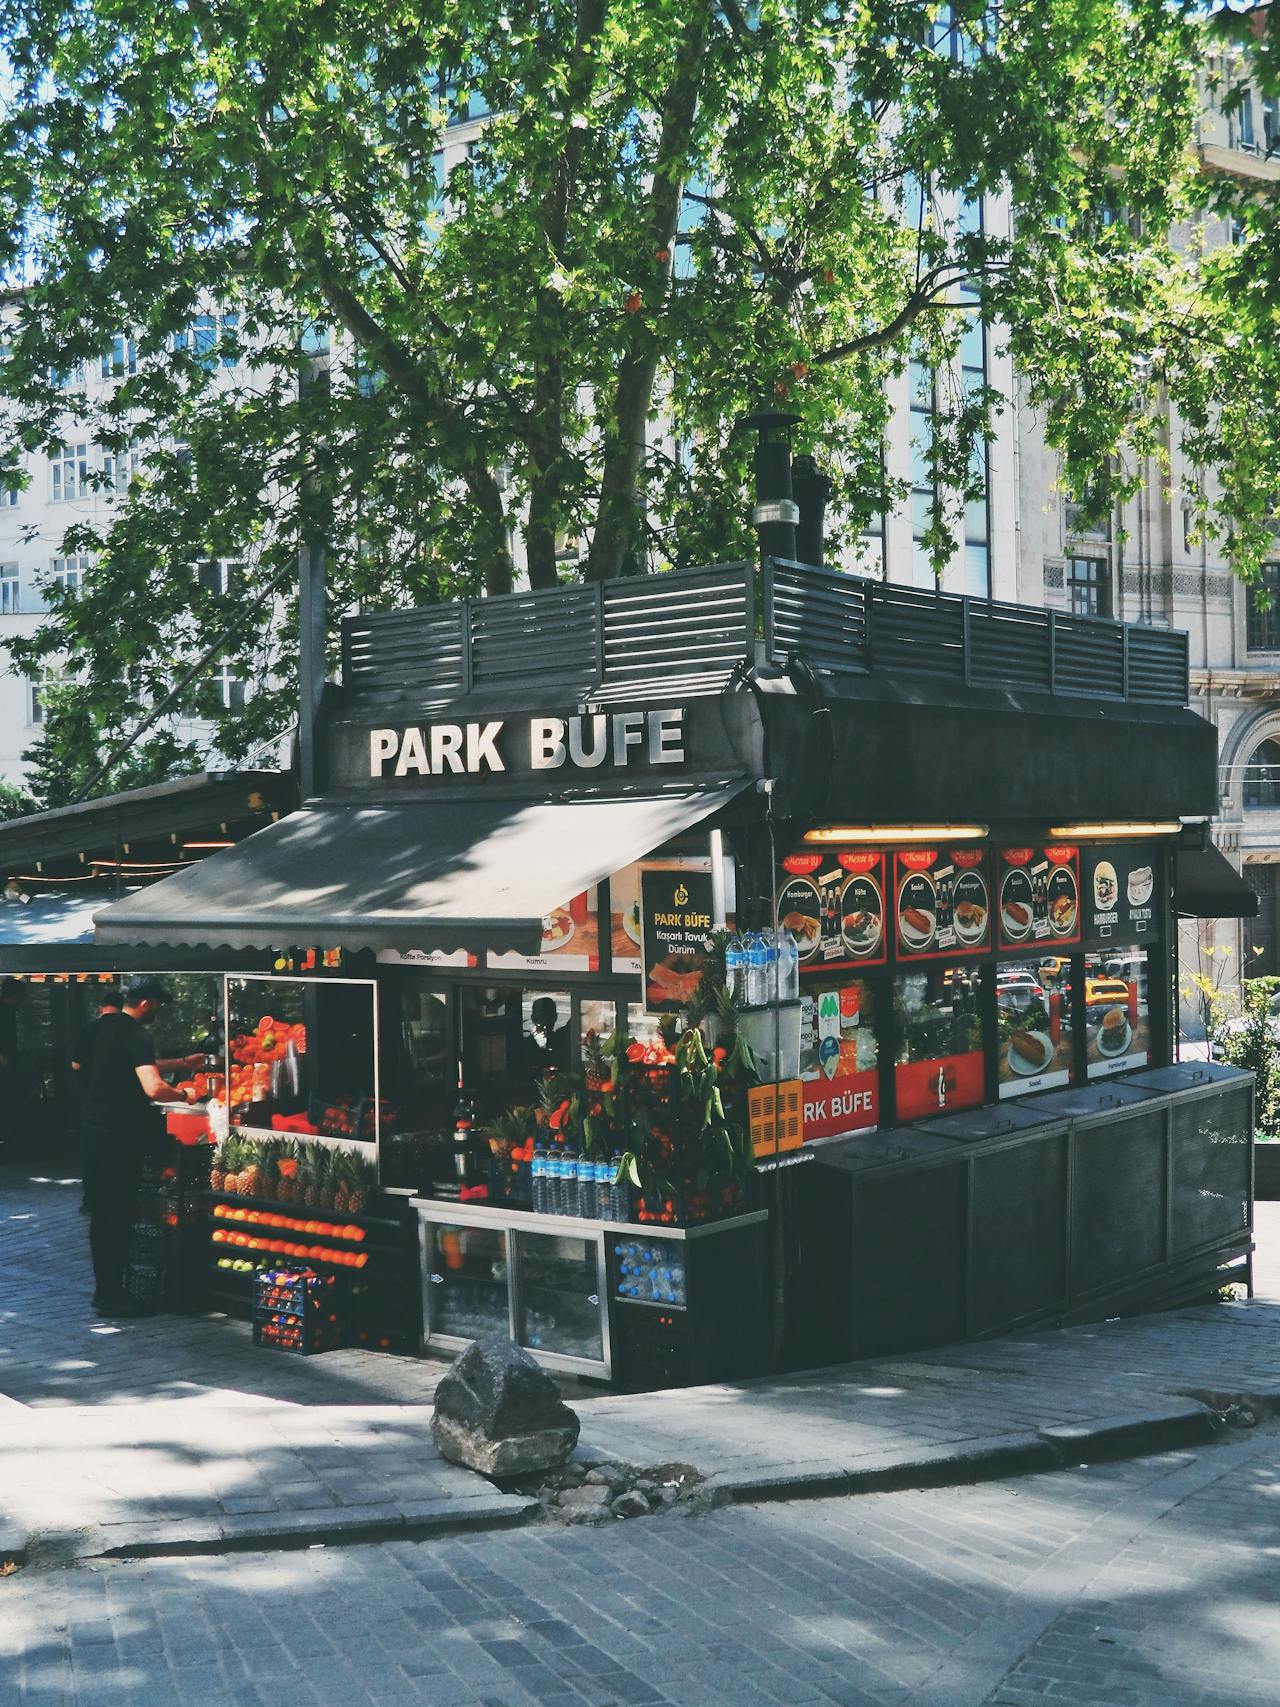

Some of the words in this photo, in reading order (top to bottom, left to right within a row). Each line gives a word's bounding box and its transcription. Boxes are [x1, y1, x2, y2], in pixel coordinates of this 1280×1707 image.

[370, 721, 505, 777] PARK
[530, 703, 686, 769] BÜFE
[654, 912, 682, 927] PARK
[684, 911, 710, 928] BÜFE
[1093, 911, 1119, 926] HAMBURGER
[656, 930, 683, 943] Kaşarlı
[684, 931, 708, 942] Tavuk
[668, 944, 696, 955] Dürüm
[526, 957, 547, 966] Kumru
[830, 1089, 874, 1118] BÜFE
